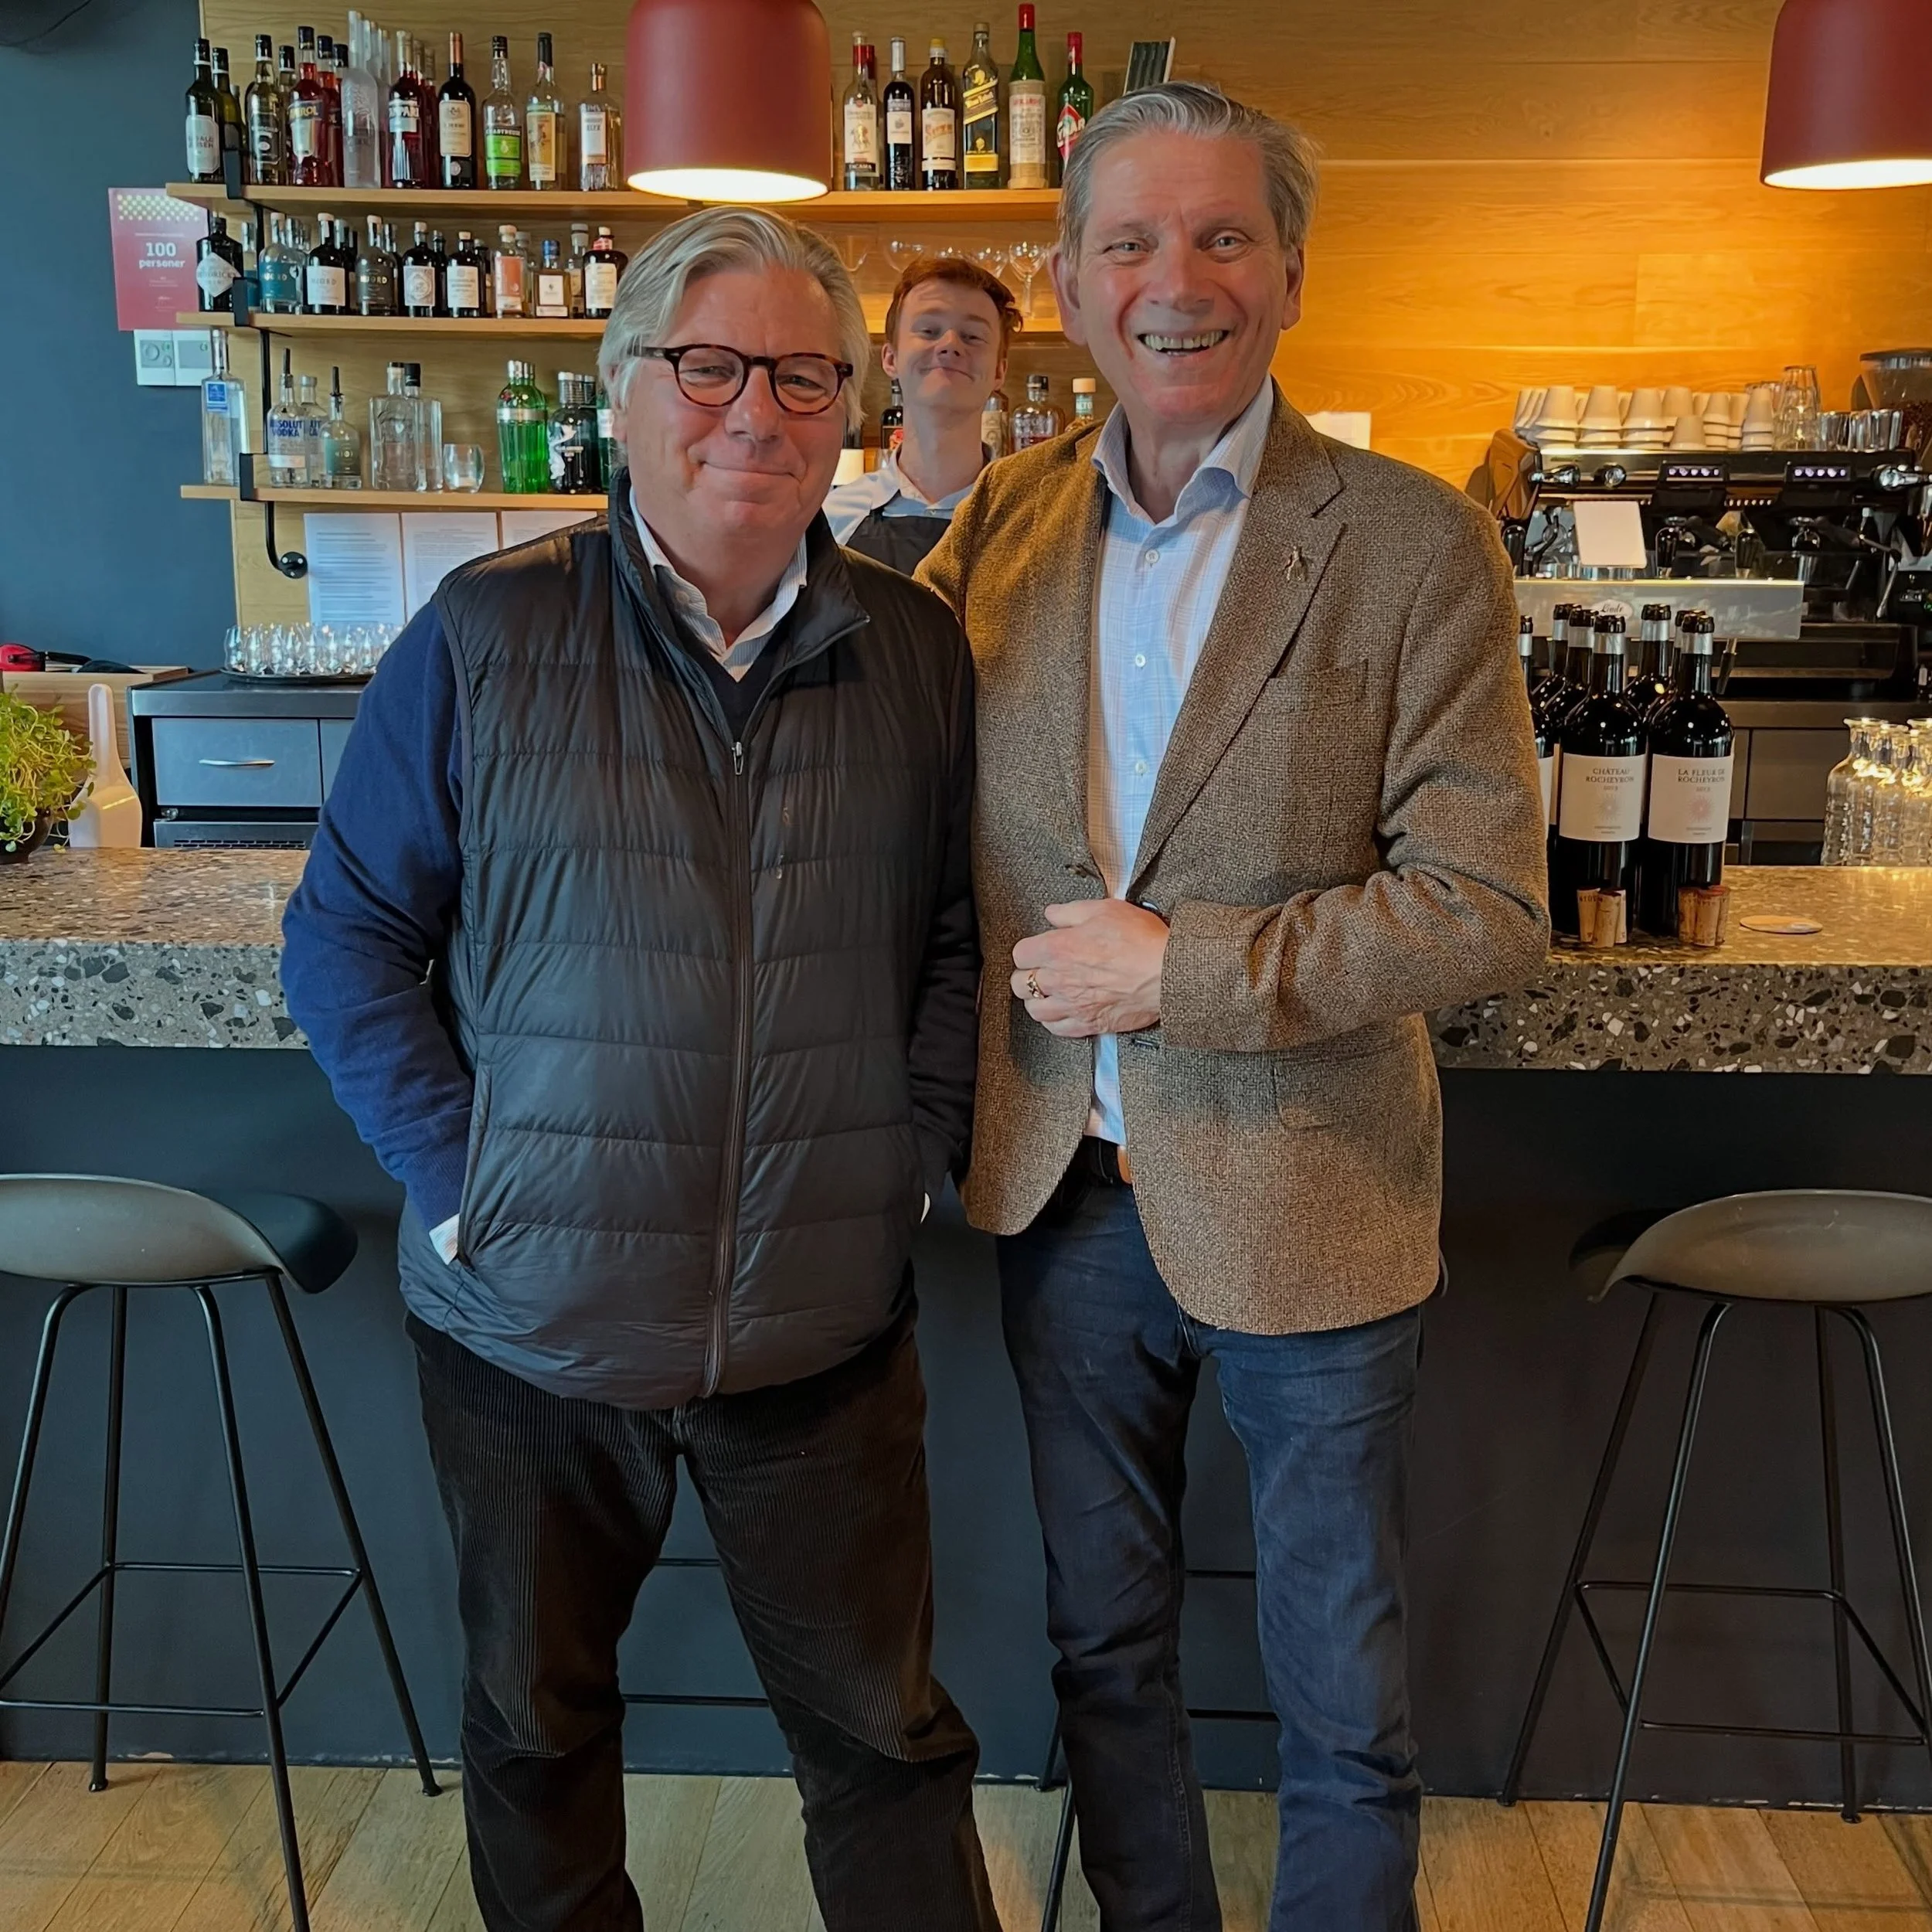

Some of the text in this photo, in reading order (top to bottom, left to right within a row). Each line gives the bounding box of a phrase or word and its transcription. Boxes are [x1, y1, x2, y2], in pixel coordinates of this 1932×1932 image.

[145, 242, 177, 257] 100
[139, 260, 185, 270] personer
[271, 428, 300, 437] VODKA
